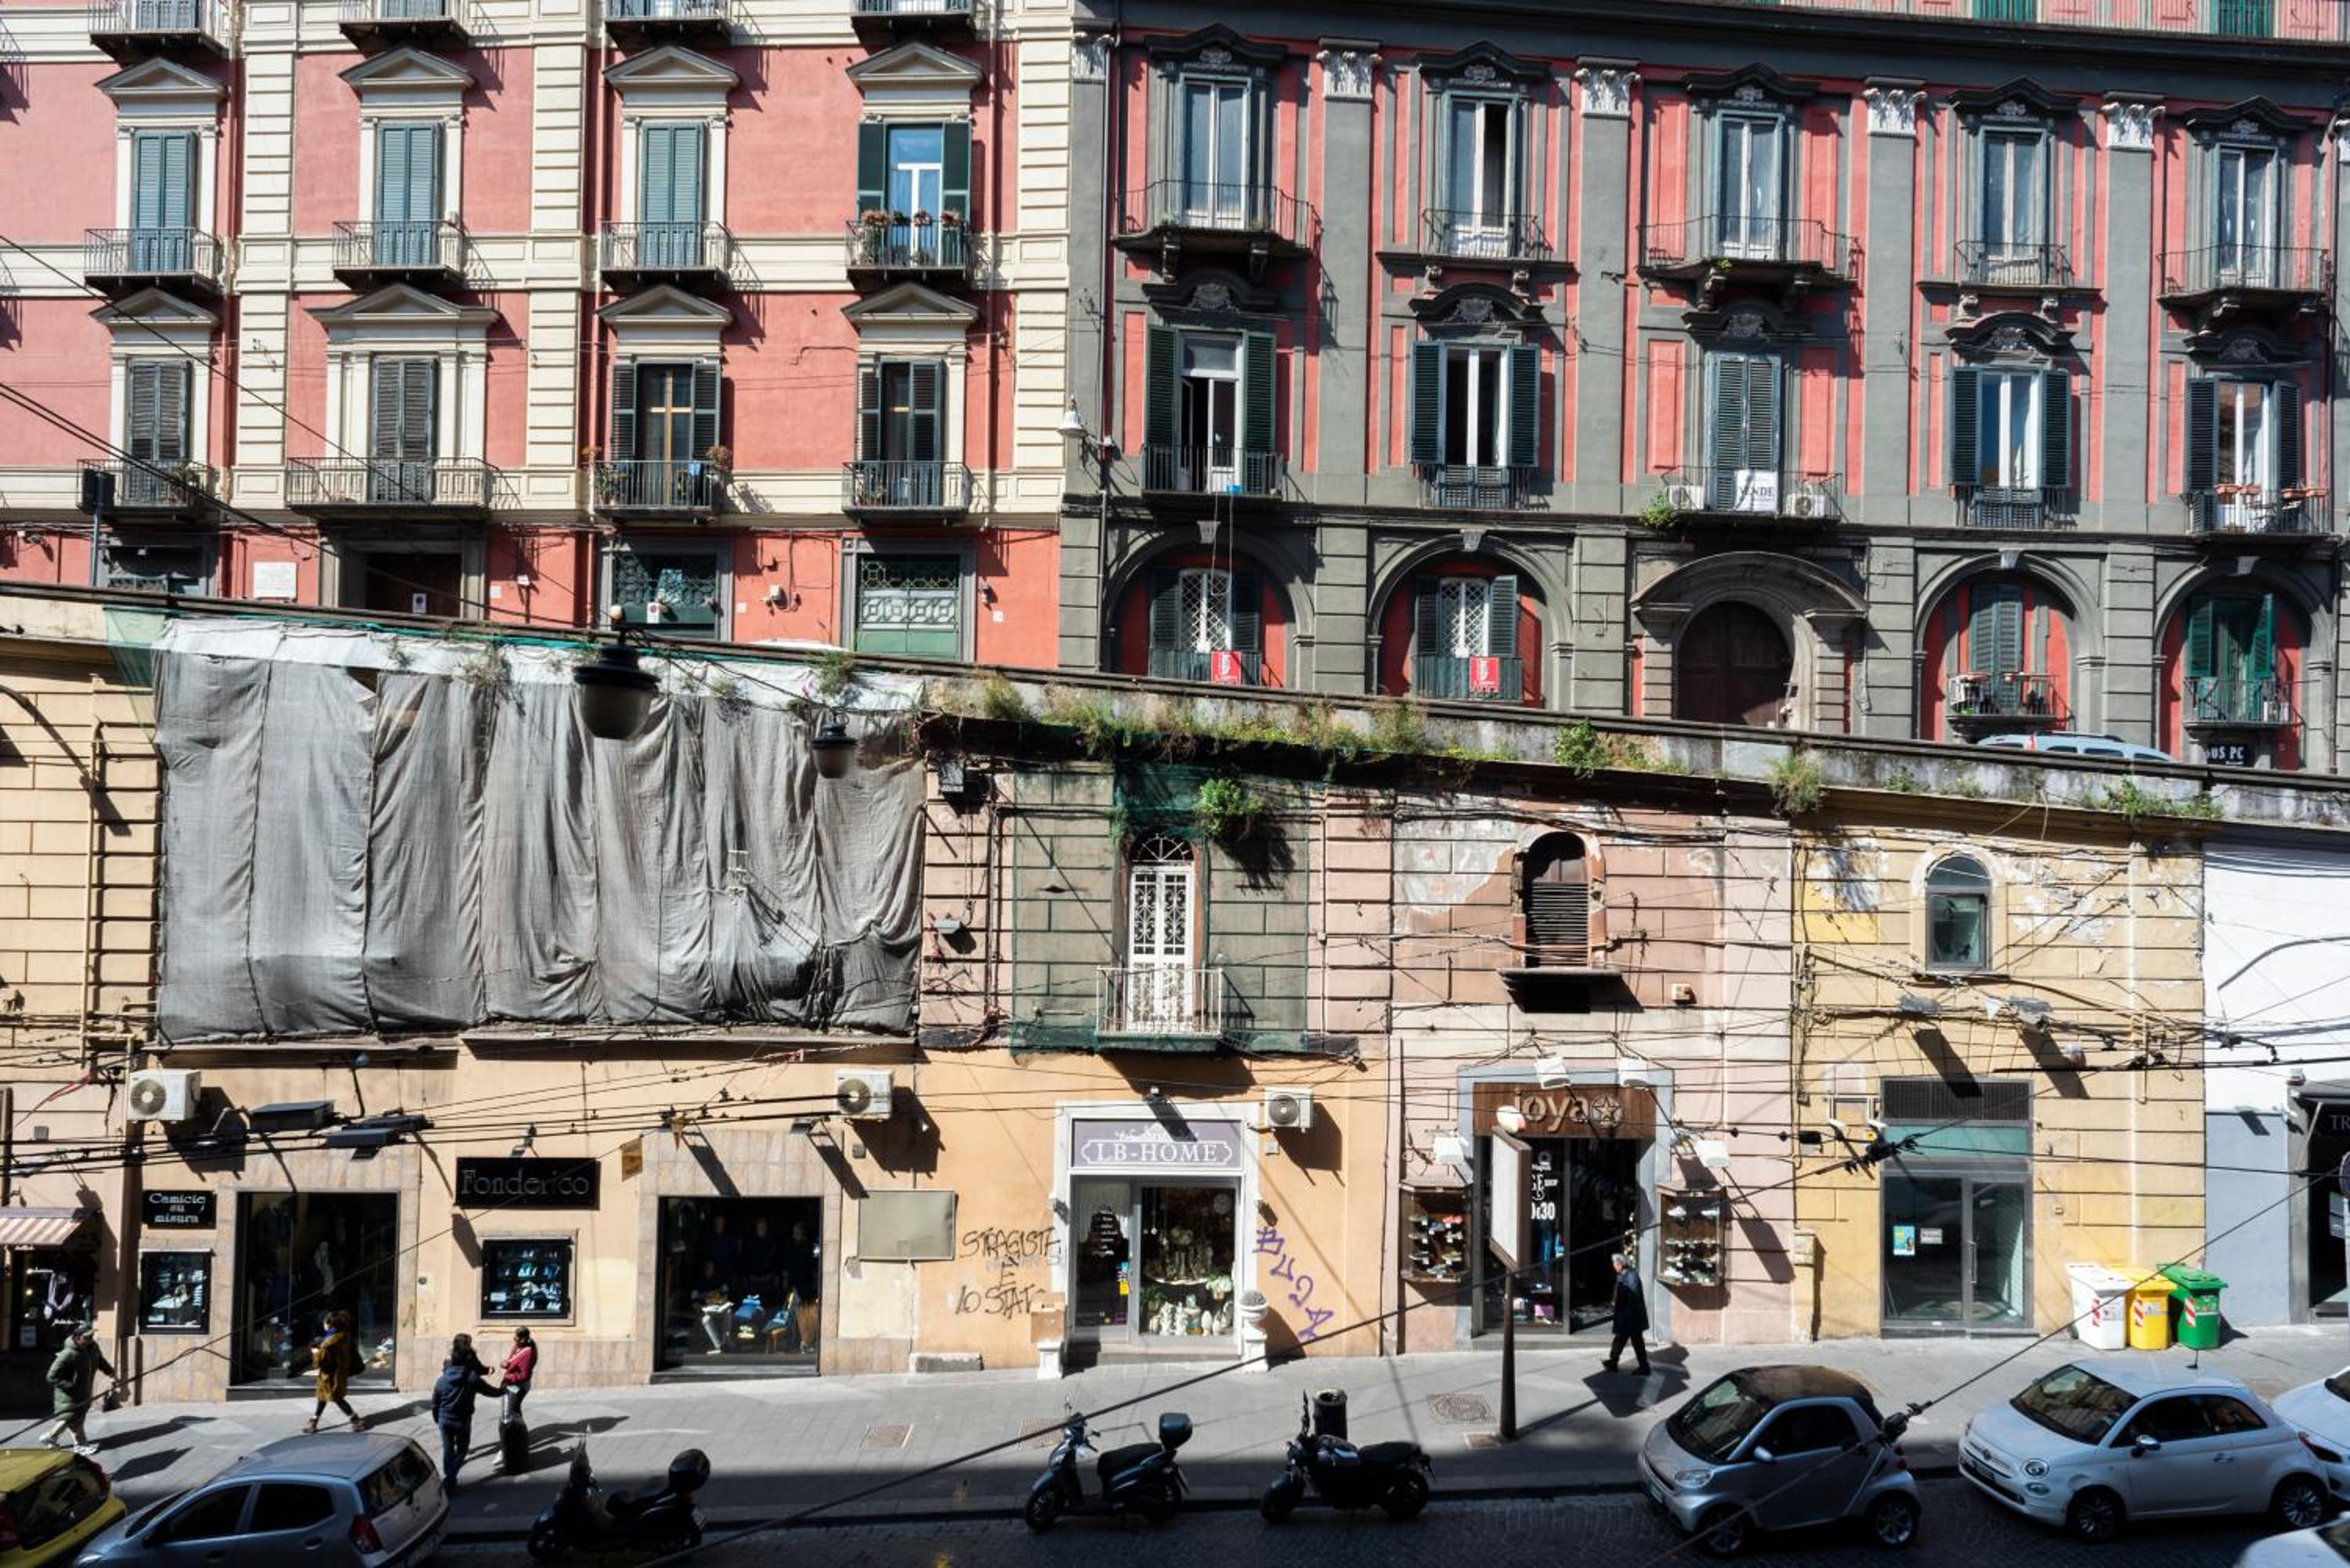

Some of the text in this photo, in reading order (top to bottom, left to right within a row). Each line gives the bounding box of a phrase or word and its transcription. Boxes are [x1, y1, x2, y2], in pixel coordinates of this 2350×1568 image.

[2229, 746, 2244, 760] PC
[1095, 1142, 1218, 1162] LB-HOME
[461, 1168, 589, 1195] Fonderico
[149, 1193, 206, 1204] Camicie
[169, 1204, 185, 1212] su
[154, 1213, 199, 1223] misura
